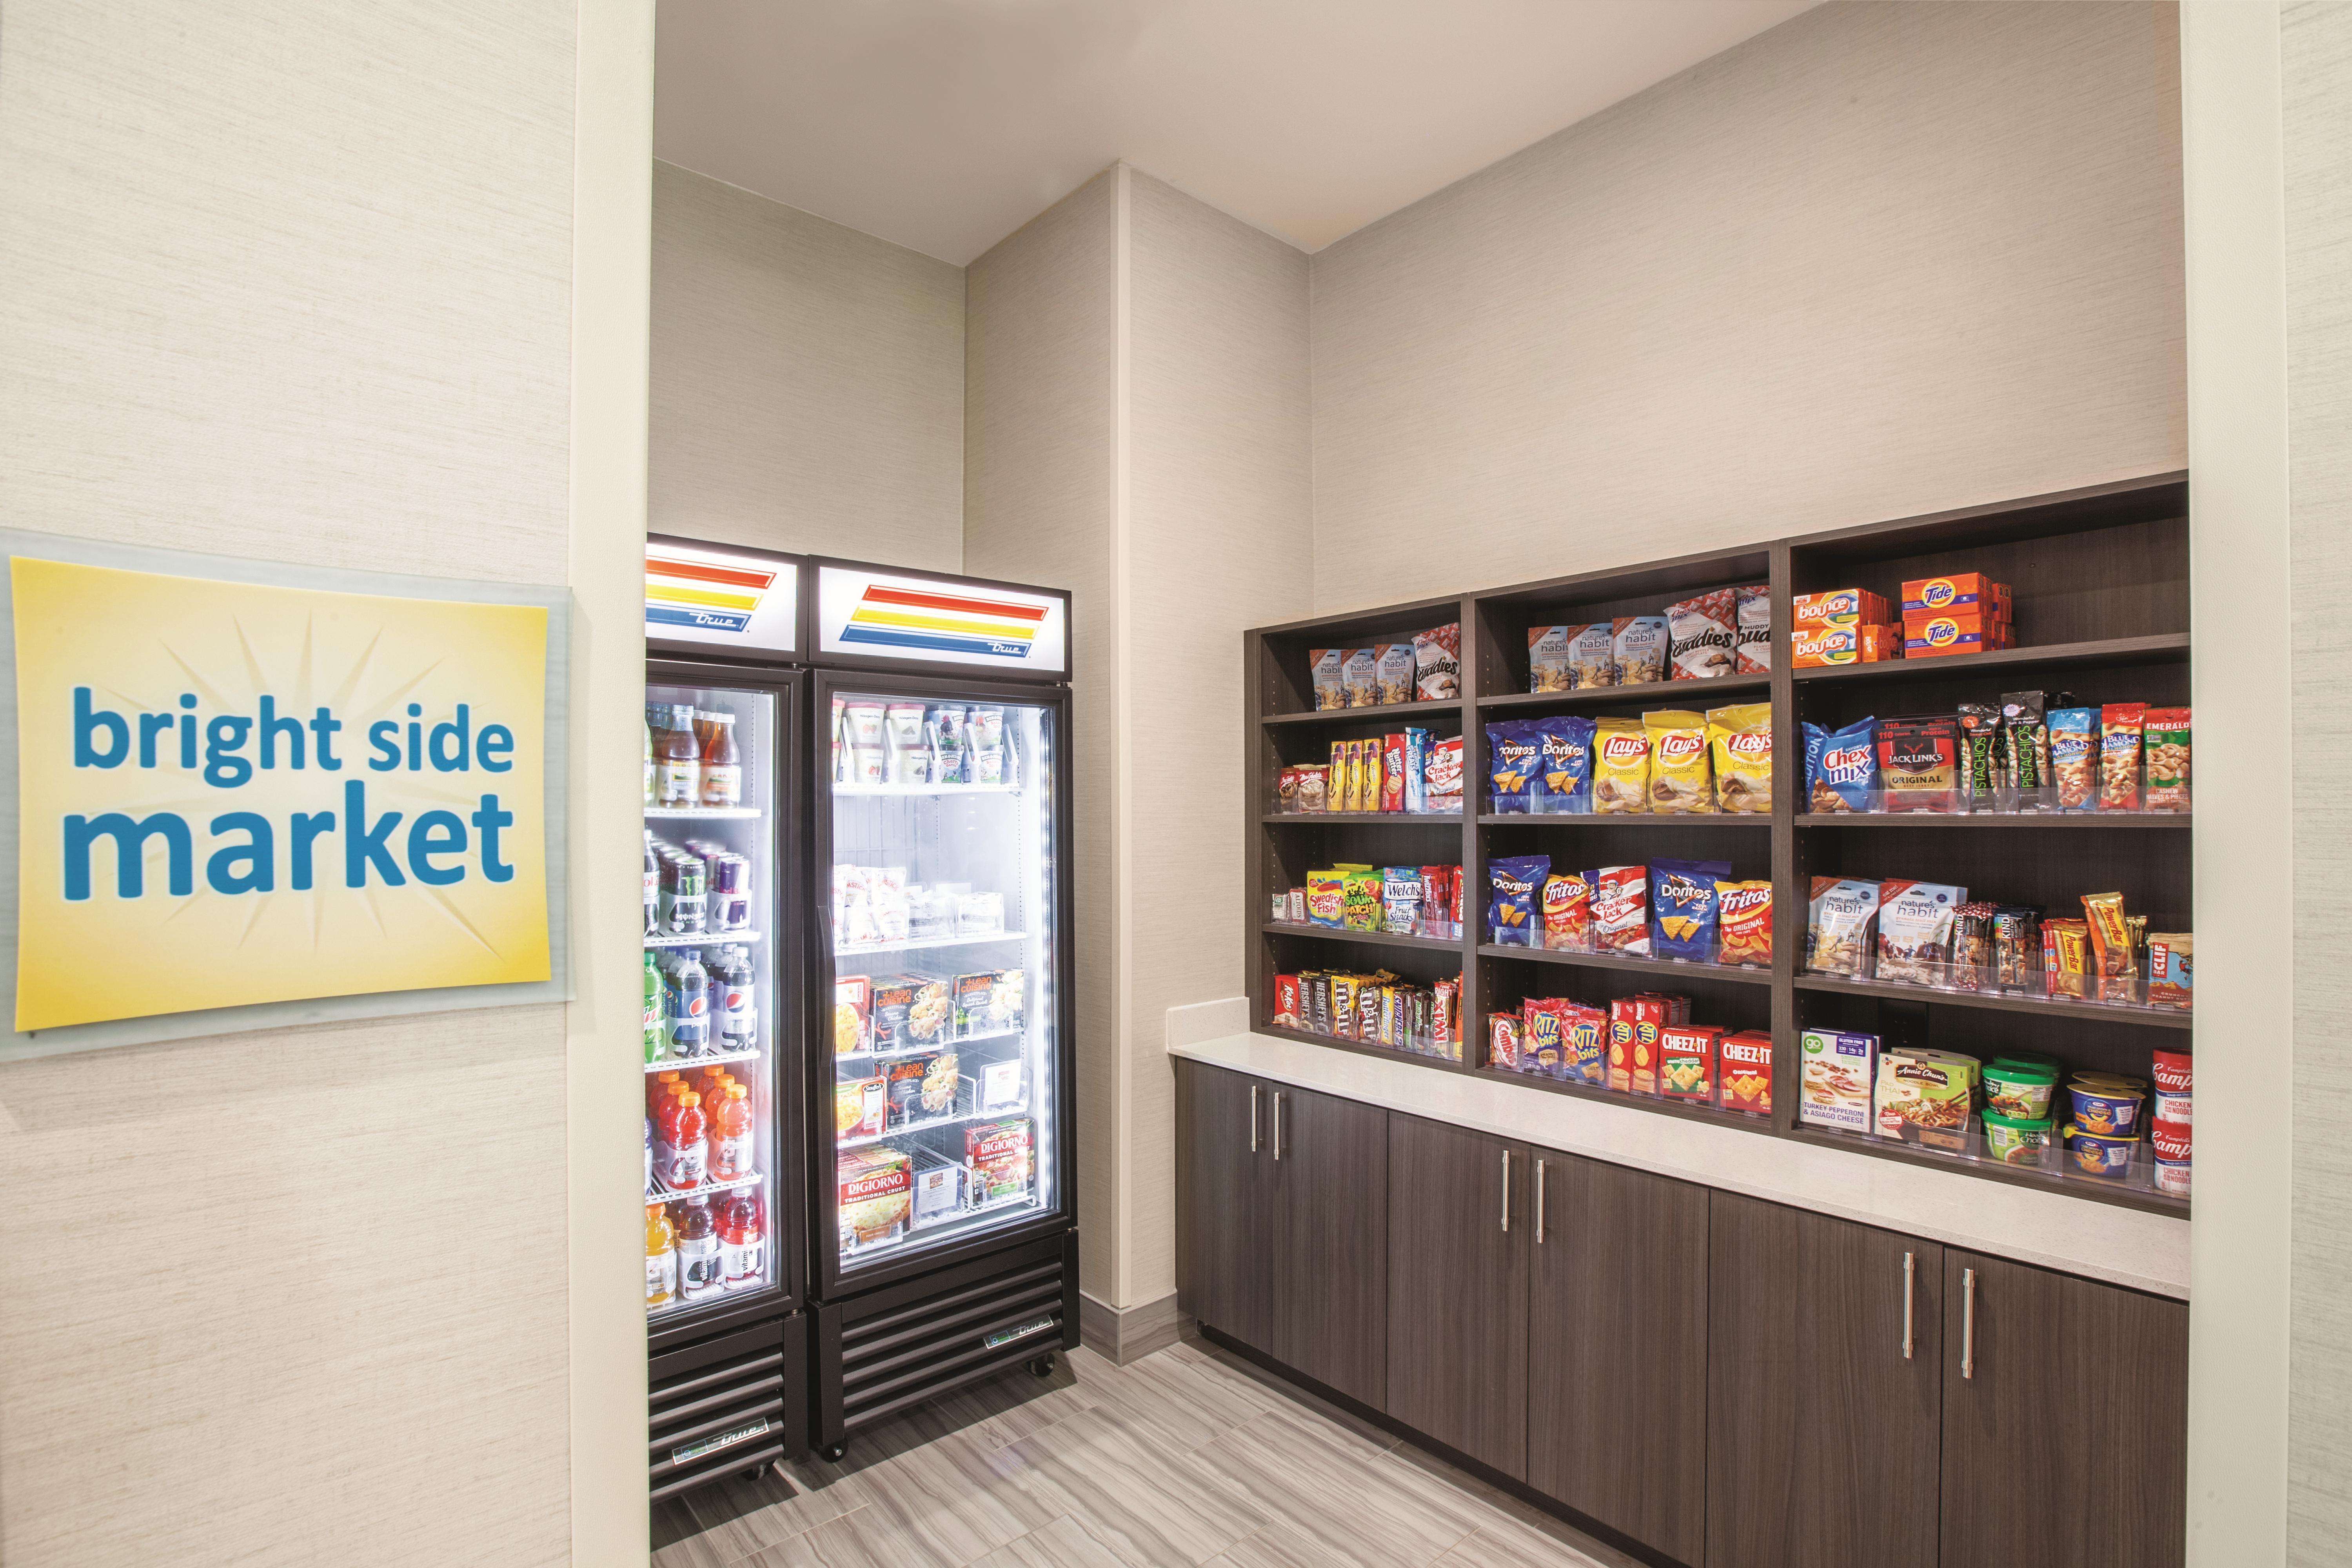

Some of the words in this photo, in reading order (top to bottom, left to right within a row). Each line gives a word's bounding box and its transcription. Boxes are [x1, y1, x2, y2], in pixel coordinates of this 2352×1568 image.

[1738, 595, 1756, 606] mix
[1925, 585, 1953, 604] Tide
[1798, 598, 1847, 620] bounce
[689, 613, 736, 627] true
[1626, 634, 1656, 643] habit
[1927, 624, 1956, 643] Tide
[988, 642, 1021, 653] true
[1580, 639, 1609, 648] habit
[1796, 636, 1845, 656] bounce
[2146, 722, 2190, 731] EMERALD
[74, 686, 342, 788] bright
[368, 703, 514, 773] side
[1878, 731, 1894, 739] 110
[2107, 734, 2129, 742] BLUE
[1542, 744, 1585, 757] Doritos
[1606, 736, 1647, 757] Lay's
[1661, 733, 1704, 755] Lay's
[1731, 733, 1771, 754] Lay's
[2055, 740, 2078, 750] BLUE
[1392, 747, 1402, 774] Nutter
[1406, 746, 1416, 771] TREATS
[1824, 746, 1871, 769] Chex
[1888, 755, 1912, 764] JACK
[1912, 753, 1943, 763] LINK'S
[2018, 725, 2034, 788] PISTACHIOS
[1386, 752, 1398, 777] Butter
[1428, 762, 1461, 775] Cracker
[1608, 767, 1639, 775] Classic
[1662, 766, 1695, 775] Classic
[1733, 760, 1769, 771] Classic
[1973, 737, 1986, 797] PISTACHIOS
[1433, 772, 1452, 784] Jack
[1830, 760, 1869, 784] mix
[1892, 775, 1943, 784] ORIGINAL
[64, 779, 514, 901] market
[1387, 884, 1420, 897] Welch's
[1493, 877, 1533, 892] Doritos
[1546, 880, 1585, 903] Fritos
[1889, 884, 1899, 892] me!
[1661, 884, 1712, 900] Doritos
[1309, 893, 1344, 907] Swedish
[1345, 895, 1372, 906] SOUR
[1596, 897, 1632, 911] Cracker
[1718, 887, 1772, 914] Fritos
[1825, 900, 1863, 914] habit
[1829, 896, 1859, 905] nature's
[1901, 900, 1935, 909] nature's
[1317, 903, 1336, 915] Fish
[1345, 905, 1373, 915] PATCH
[1395, 906, 1411, 915] Fruit
[1553, 909, 1577, 920] ORIGINAL
[1600, 907, 1623, 921] Jack
[1897, 905, 1939, 918] habit
[1389, 913, 1413, 921] Snacks
[1733, 917, 1765, 931] ORIGINAL
[1603, 922, 1628, 933] Original
[1955, 914, 1964, 935] KIND
[2001, 917, 2011, 939] KIND
[2104, 906, 2123, 944] PowerBar
[2065, 934, 2079, 971] PowerBar
[2153, 944, 2167, 970] CLIF
[972, 976, 992, 985] Lean
[890, 989, 912, 998] Lean
[1435, 987, 1453, 998] RIGHT
[1300, 982, 1310, 1018] HERSHEY'S
[1316, 981, 1327, 1022] HERSHEY'S
[1382, 996, 1390, 1040] Butterfinger
[1394, 995, 1404, 1037] SNICKERS
[1434, 999, 1449, 1044] TWIX
[1534, 1014, 1560, 1036] RITZ
[1615, 1021, 1629, 1043] RITZ
[1641, 1021, 1654, 1043] RITZ
[1498, 1024, 1517, 1064] Combos
[1538, 1034, 1559, 1047] bits
[1572, 1026, 1599, 1050] RITZ
[1805, 1038, 1821, 1049] go
[1577, 1047, 1599, 1061] bits
[902, 1062, 923, 1071] Lean
[1897, 1066, 1921, 1076] Annie
[1922, 1069, 1948, 1081] Chun's
[1880, 1085, 1900, 1095] THAI
[1804, 1102, 1827, 1111] TURKEY
[1829, 1106, 1864, 1118] PEPPERONI
[2165, 1099, 2192, 1108] CHICKEN
[1810, 1110, 1836, 1120] ASIAGO
[1837, 1114, 1864, 1125] CHEESE
[2172, 1107, 2192, 1116] NOODLE
[978, 1150, 1013, 1161] TRADITIONAL
[2163, 1167, 2190, 1177] CHICKEN
[2170, 1175, 2192, 1184] NOODLE
[845, 1191, 886, 1203] TRADITIONAL
[887, 1186, 906, 1194] CRUST
[1013, 1321, 1050, 1335] true
[713, 1426, 764, 1445] true
